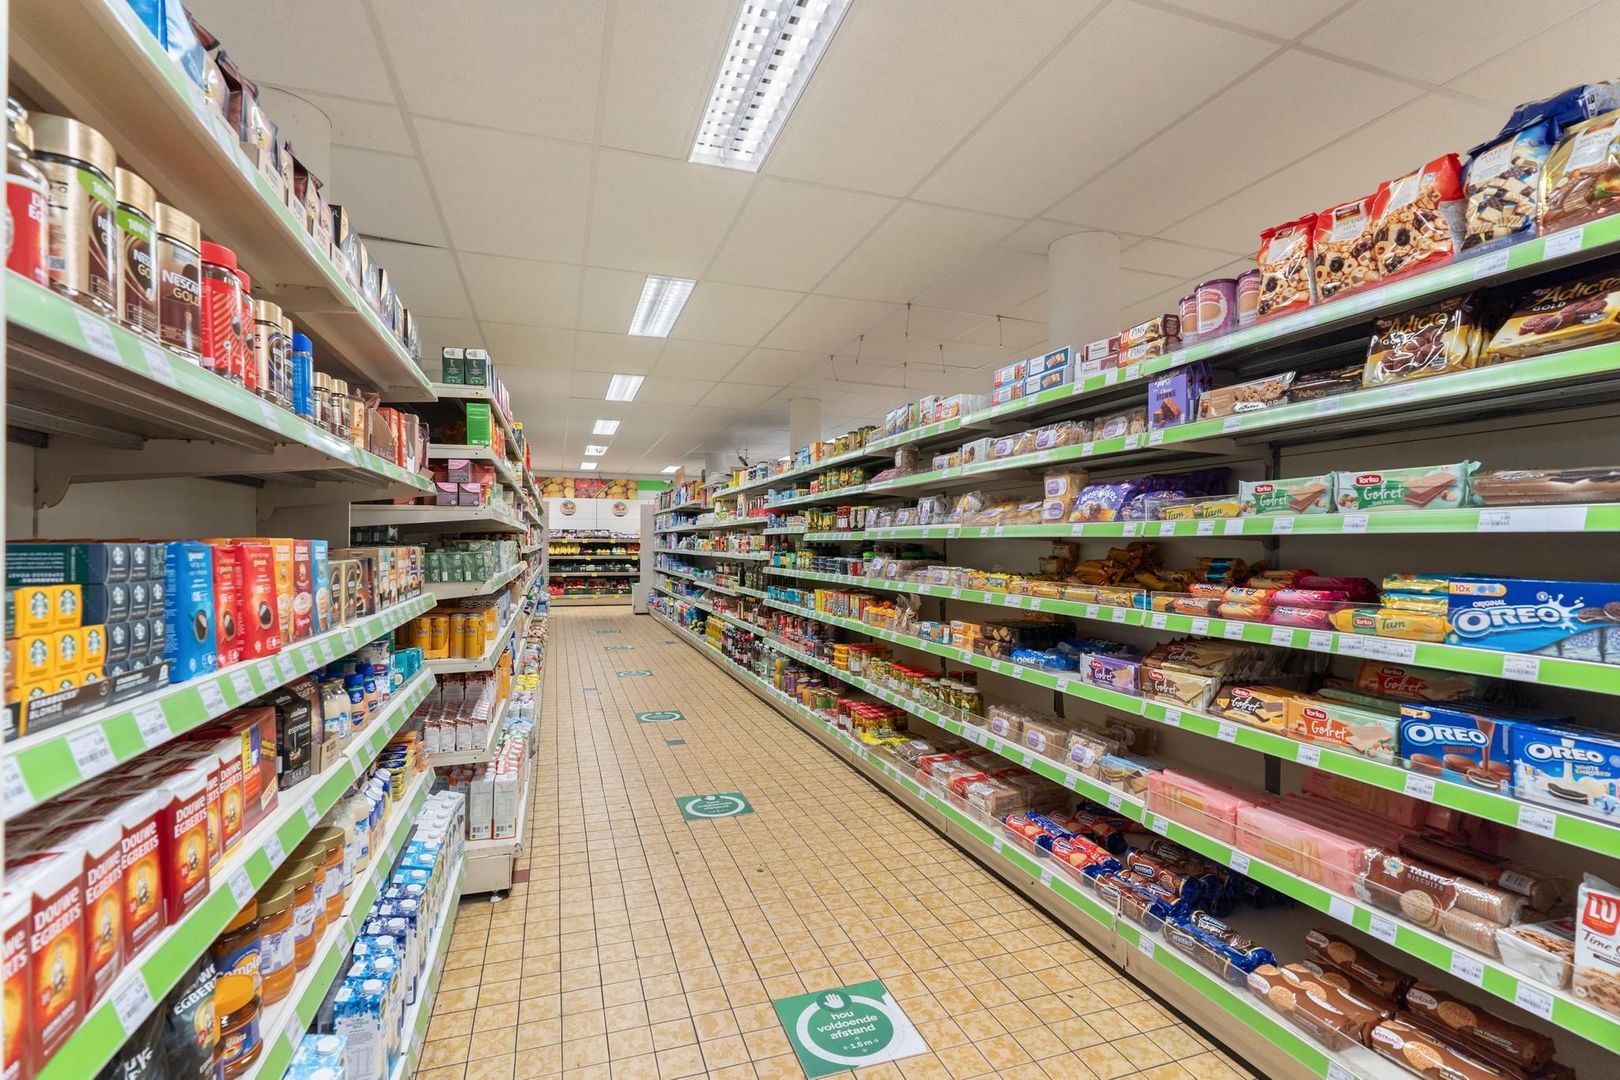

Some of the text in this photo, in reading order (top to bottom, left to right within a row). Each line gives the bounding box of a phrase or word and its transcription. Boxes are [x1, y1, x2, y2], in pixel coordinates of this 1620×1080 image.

[1533, 302, 1566, 312] GOLD
[1260, 489, 1288, 507] Gofret
[1363, 480, 1405, 500] Gofret
[1455, 584, 1471, 592] 10x
[1472, 600, 1506, 608] ORIGINAL
[1380, 617, 1407, 631] Tam
[1457, 606, 1561, 632] OREO
[1305, 708, 1326, 720] Torku
[1311, 719, 1349, 741] Gofret
[1407, 725, 1487, 744] OREO
[1527, 744, 1605, 763] OREO
[1406, 873, 1444, 891] BISCUITS
[1589, 895, 1617, 923] LU
[1582, 929, 1613, 951] Time
[817, 1015, 878, 1033] voldoende
[831, 1010, 854, 1021] hou
[830, 1024, 876, 1040] afstand
